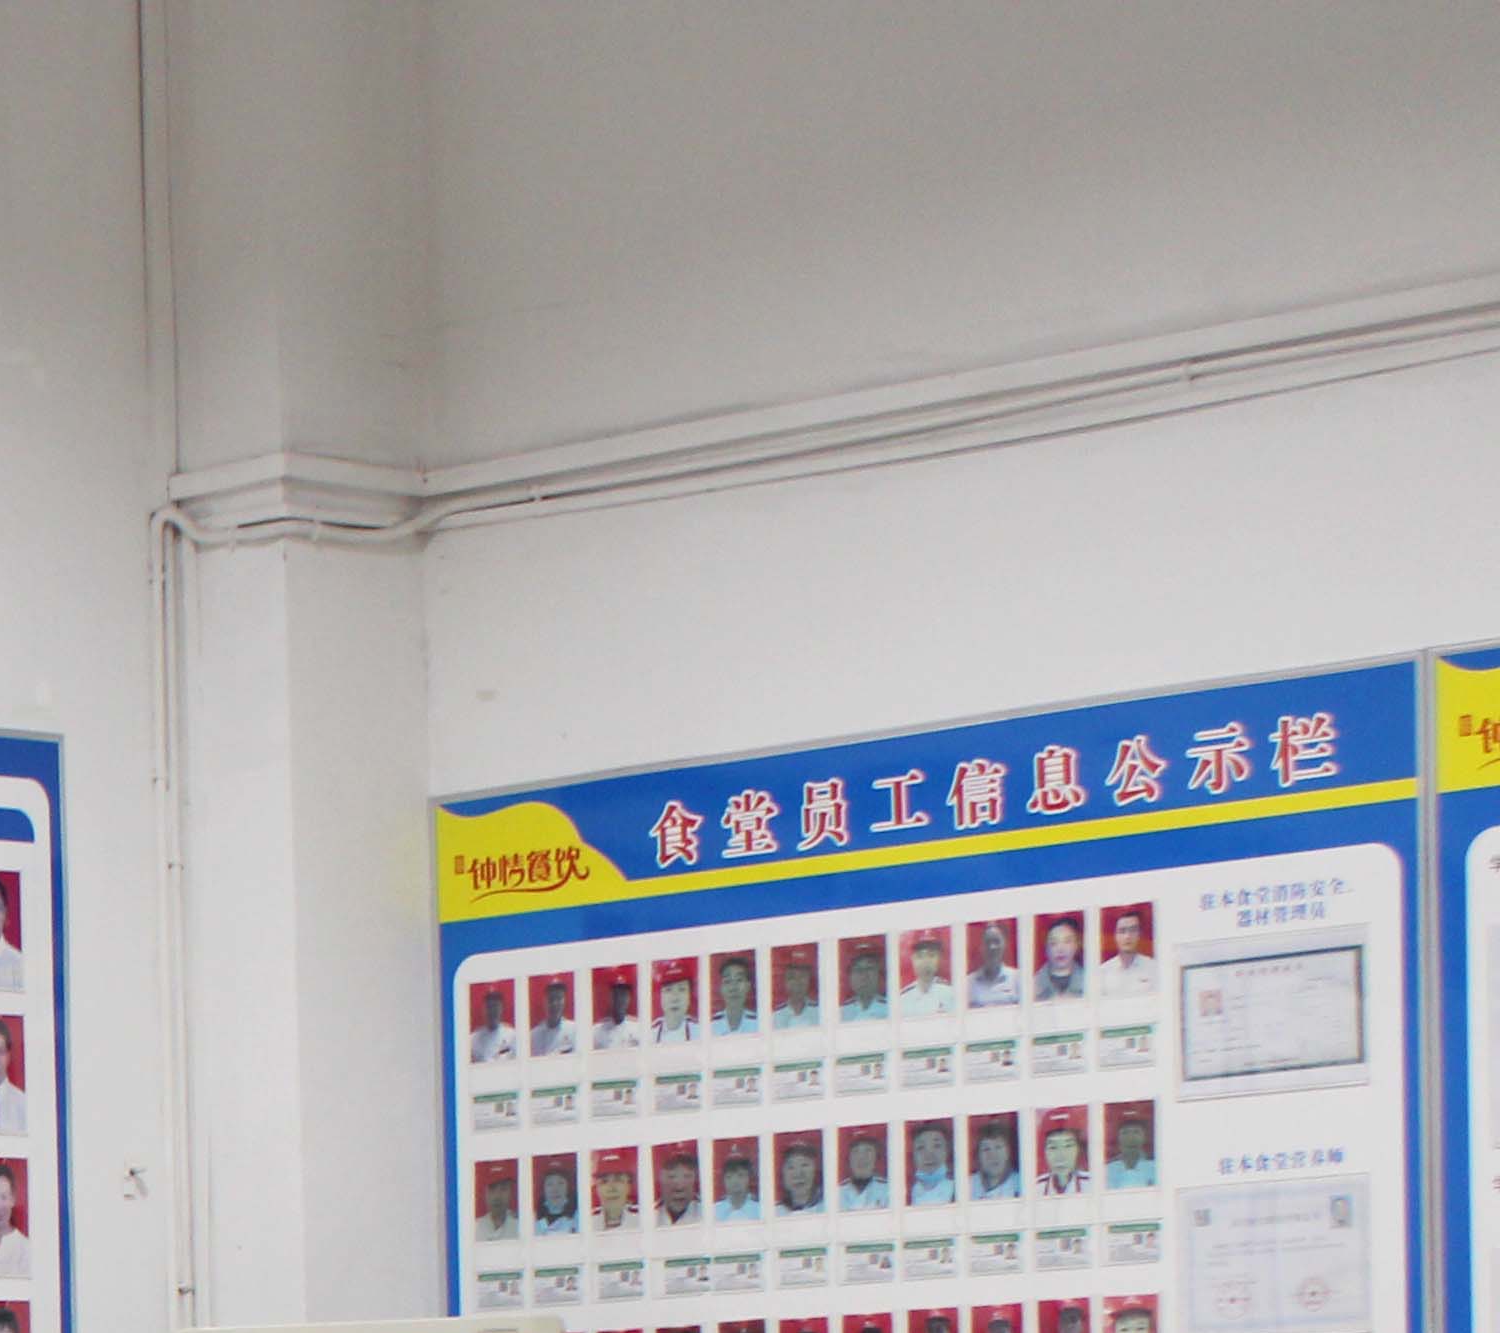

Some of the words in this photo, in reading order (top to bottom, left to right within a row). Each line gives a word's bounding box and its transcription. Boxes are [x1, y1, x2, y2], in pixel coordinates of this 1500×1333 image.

[650, 711, 1339, 867] 食堂员工信息公示栏
[468, 846, 590, 893] 钟情餐饮
[1236, 901, 1326, 928] 器材管理员
[1218, 1146, 1344, 1175] 驻本食堂营养师
